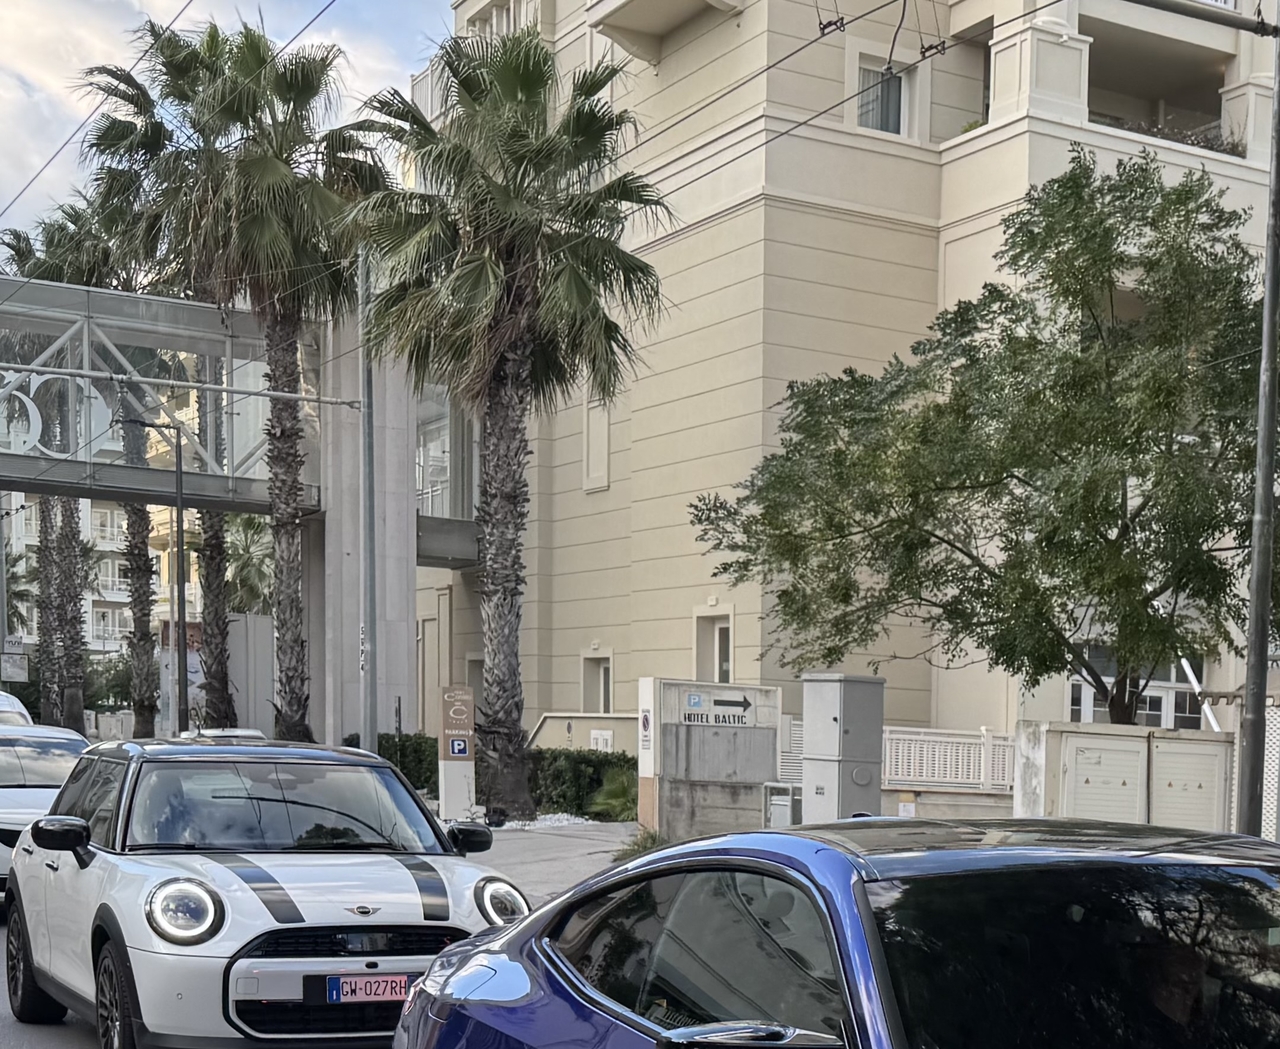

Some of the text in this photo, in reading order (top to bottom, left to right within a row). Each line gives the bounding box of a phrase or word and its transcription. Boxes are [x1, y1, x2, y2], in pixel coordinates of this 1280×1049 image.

[689, 696, 699, 706] P
[683, 712, 747, 725] HOTEL BALTIC
[453, 740, 465, 754] P
